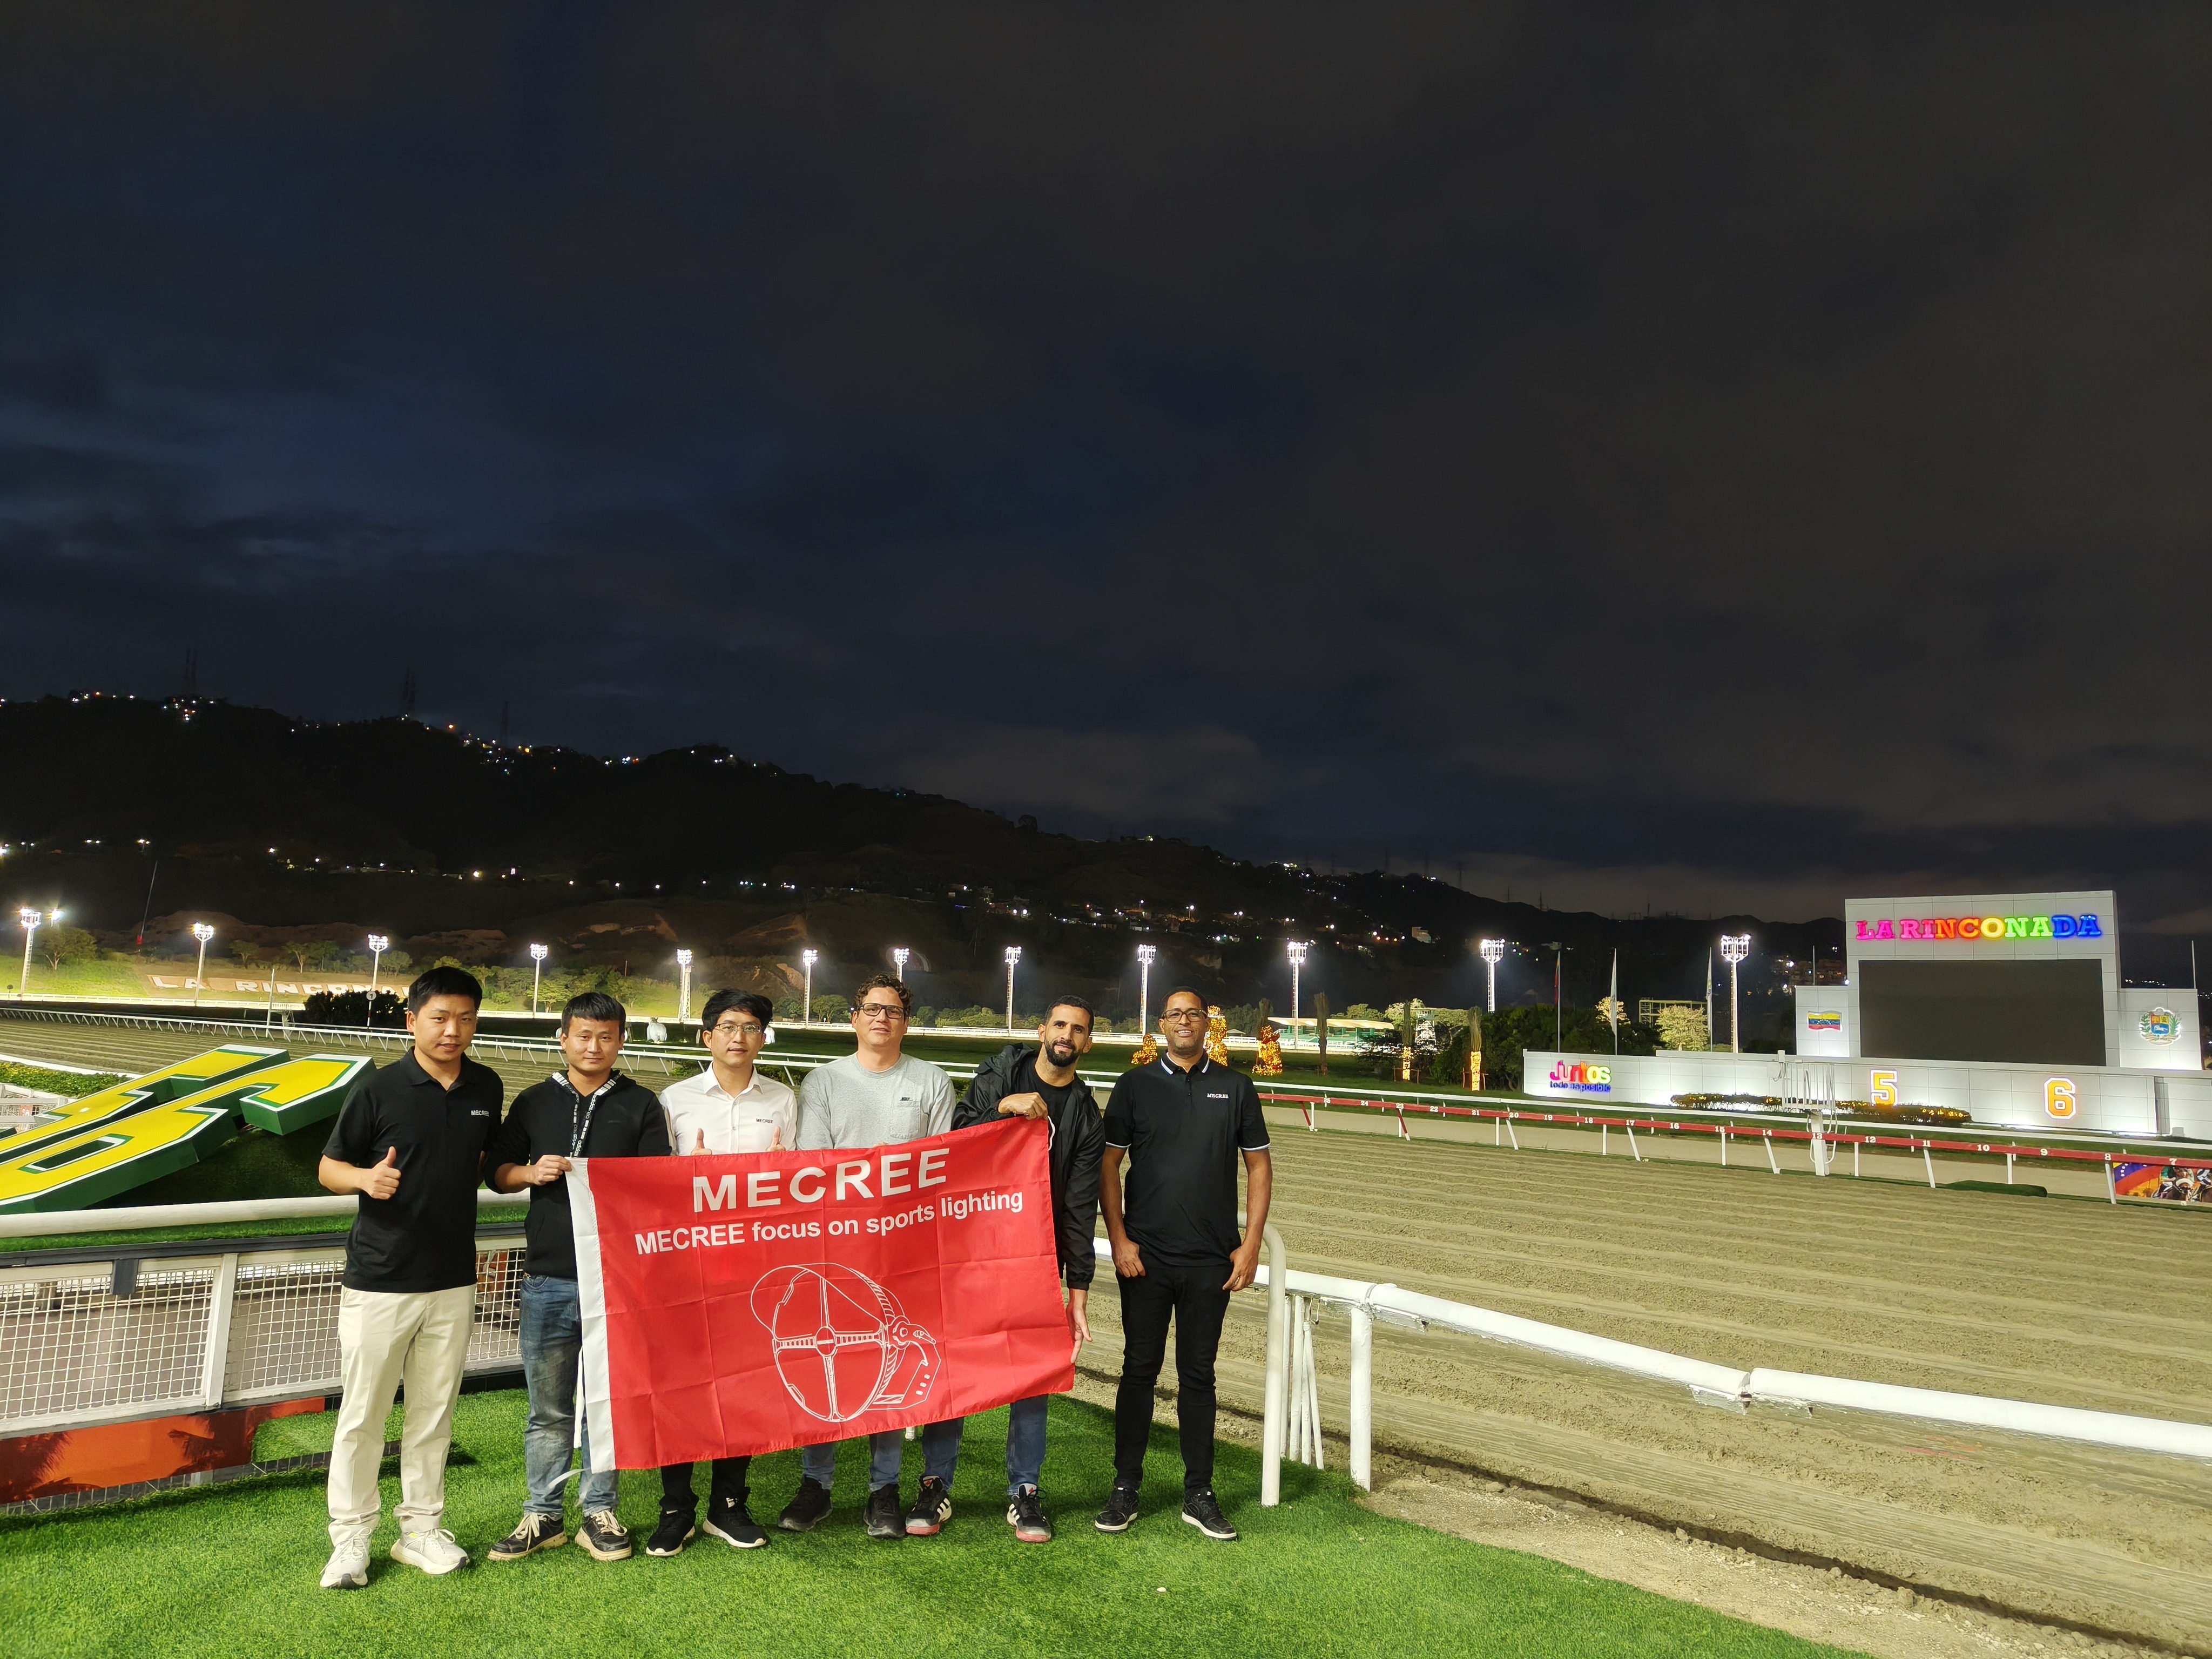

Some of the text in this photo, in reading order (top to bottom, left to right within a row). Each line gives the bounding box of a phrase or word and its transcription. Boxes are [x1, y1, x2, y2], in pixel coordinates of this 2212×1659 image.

[1856, 914, 2102, 939] LA RINCONADA
[1871, 1069, 1897, 1106] 5
[2044, 1077, 2075, 1120] 6
[693, 1148, 949, 1213] MECREE
[635, 1191, 1023, 1255] MECREE focus on sports lighting
